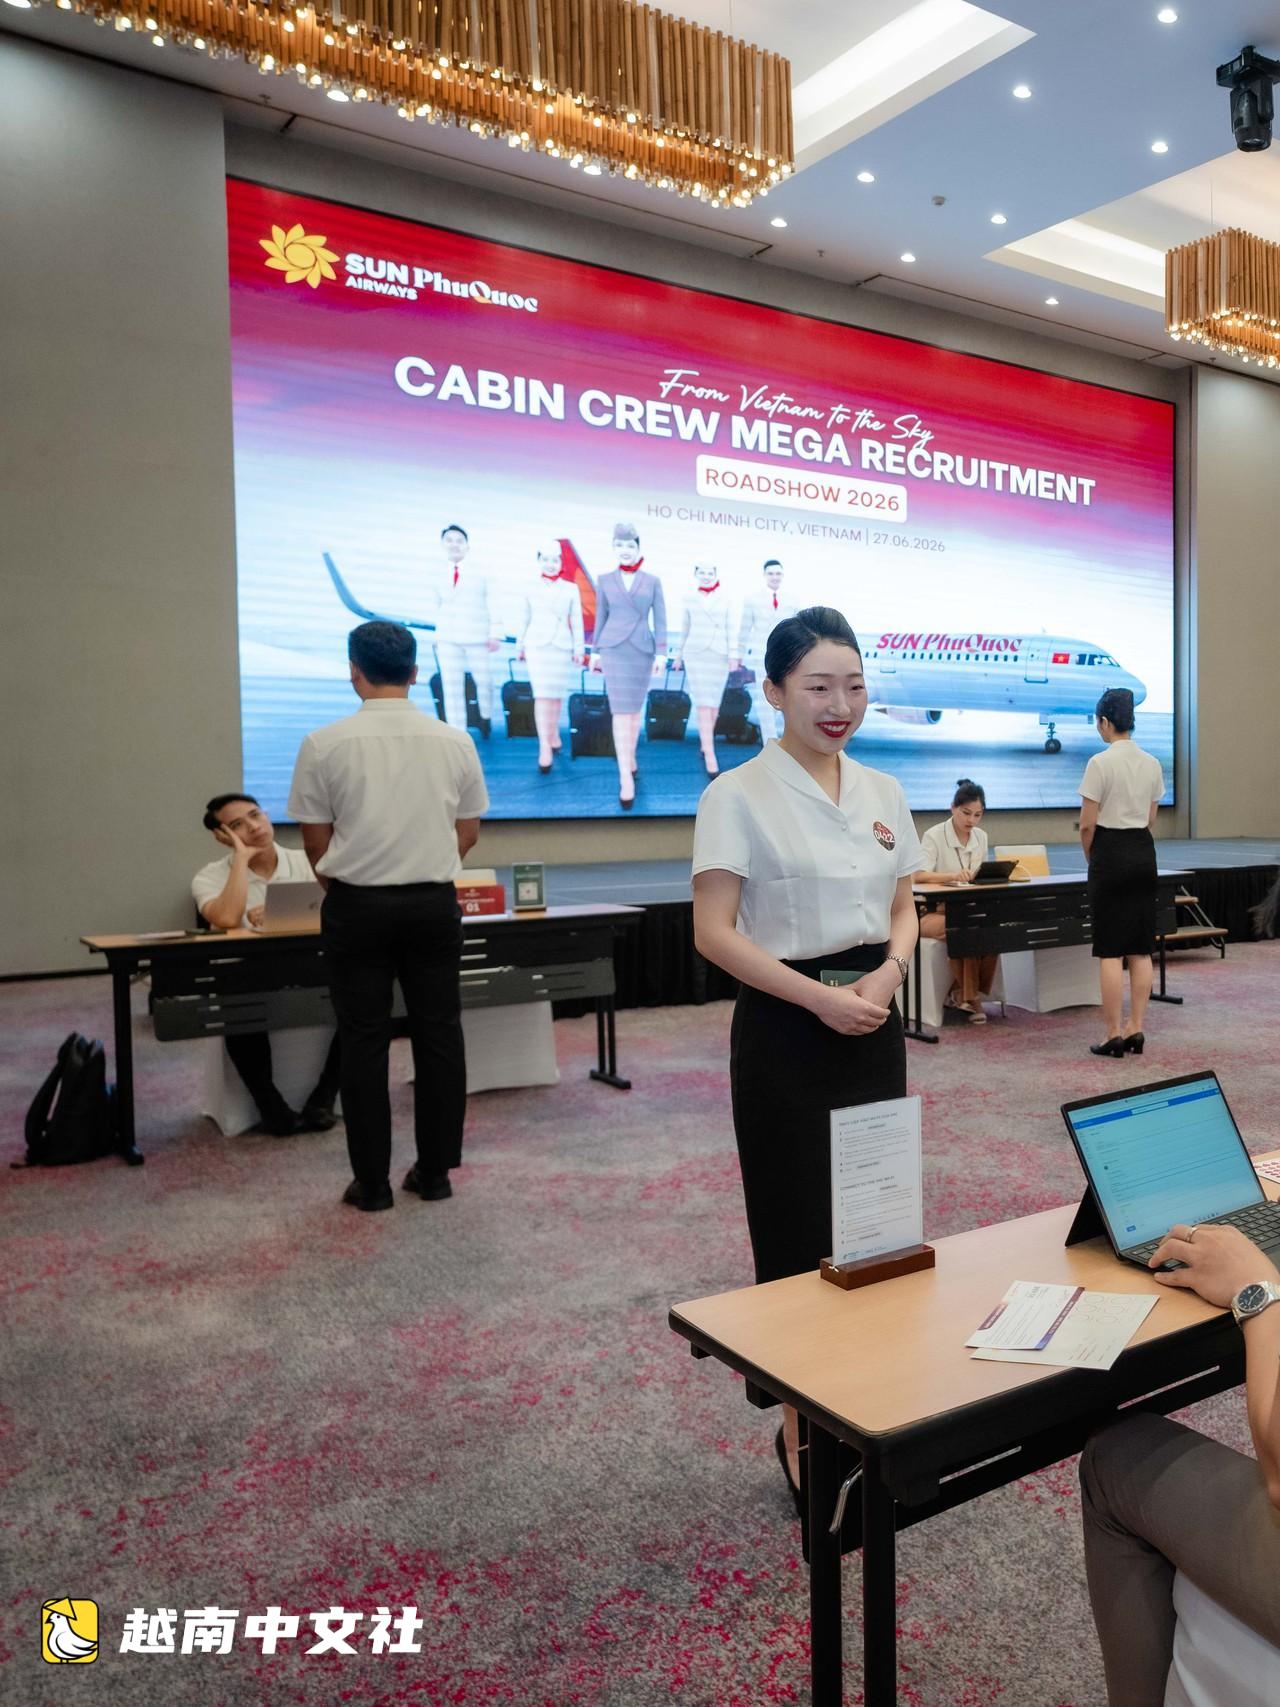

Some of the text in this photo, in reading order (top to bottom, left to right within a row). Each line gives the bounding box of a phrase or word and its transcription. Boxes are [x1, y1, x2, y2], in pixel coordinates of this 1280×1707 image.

[344, 252, 539, 313] SUN PhuQuoc
[345, 277, 418, 300] AIRWAYS
[394, 356, 1096, 506] CABIN CREW MEGA RECRUITMENT
[660, 369, 934, 451] From Vietnam to the Sky
[705, 468, 900, 512] ROADSHOW 2026
[646, 503, 946, 553] HO CHI MINH CITY, VIETNAM 27.06.2026
[877, 633, 1022, 652] SUN PhuQuoc
